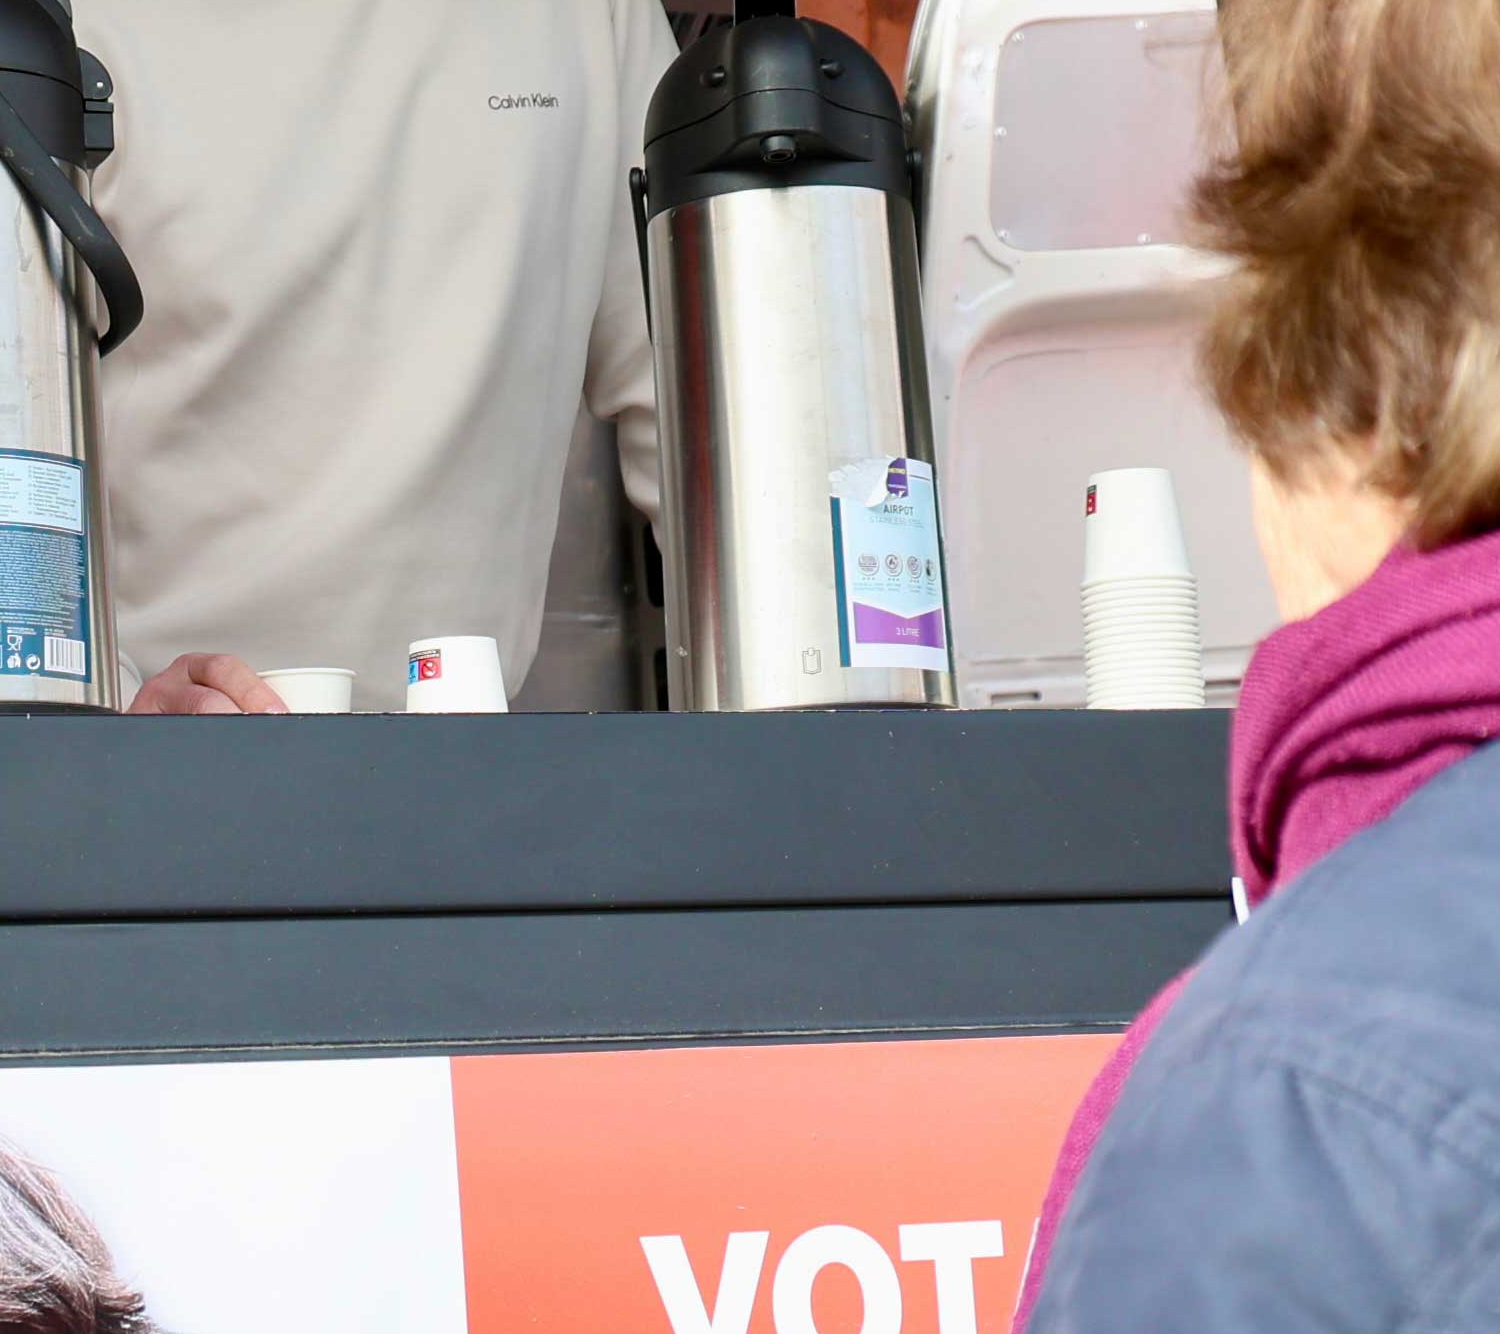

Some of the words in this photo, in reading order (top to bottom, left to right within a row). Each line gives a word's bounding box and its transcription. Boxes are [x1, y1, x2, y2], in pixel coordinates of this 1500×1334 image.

[488, 94, 531, 110] Calvin
[531, 93, 559, 108] Klein
[883, 504, 914, 516] AIRPOT
